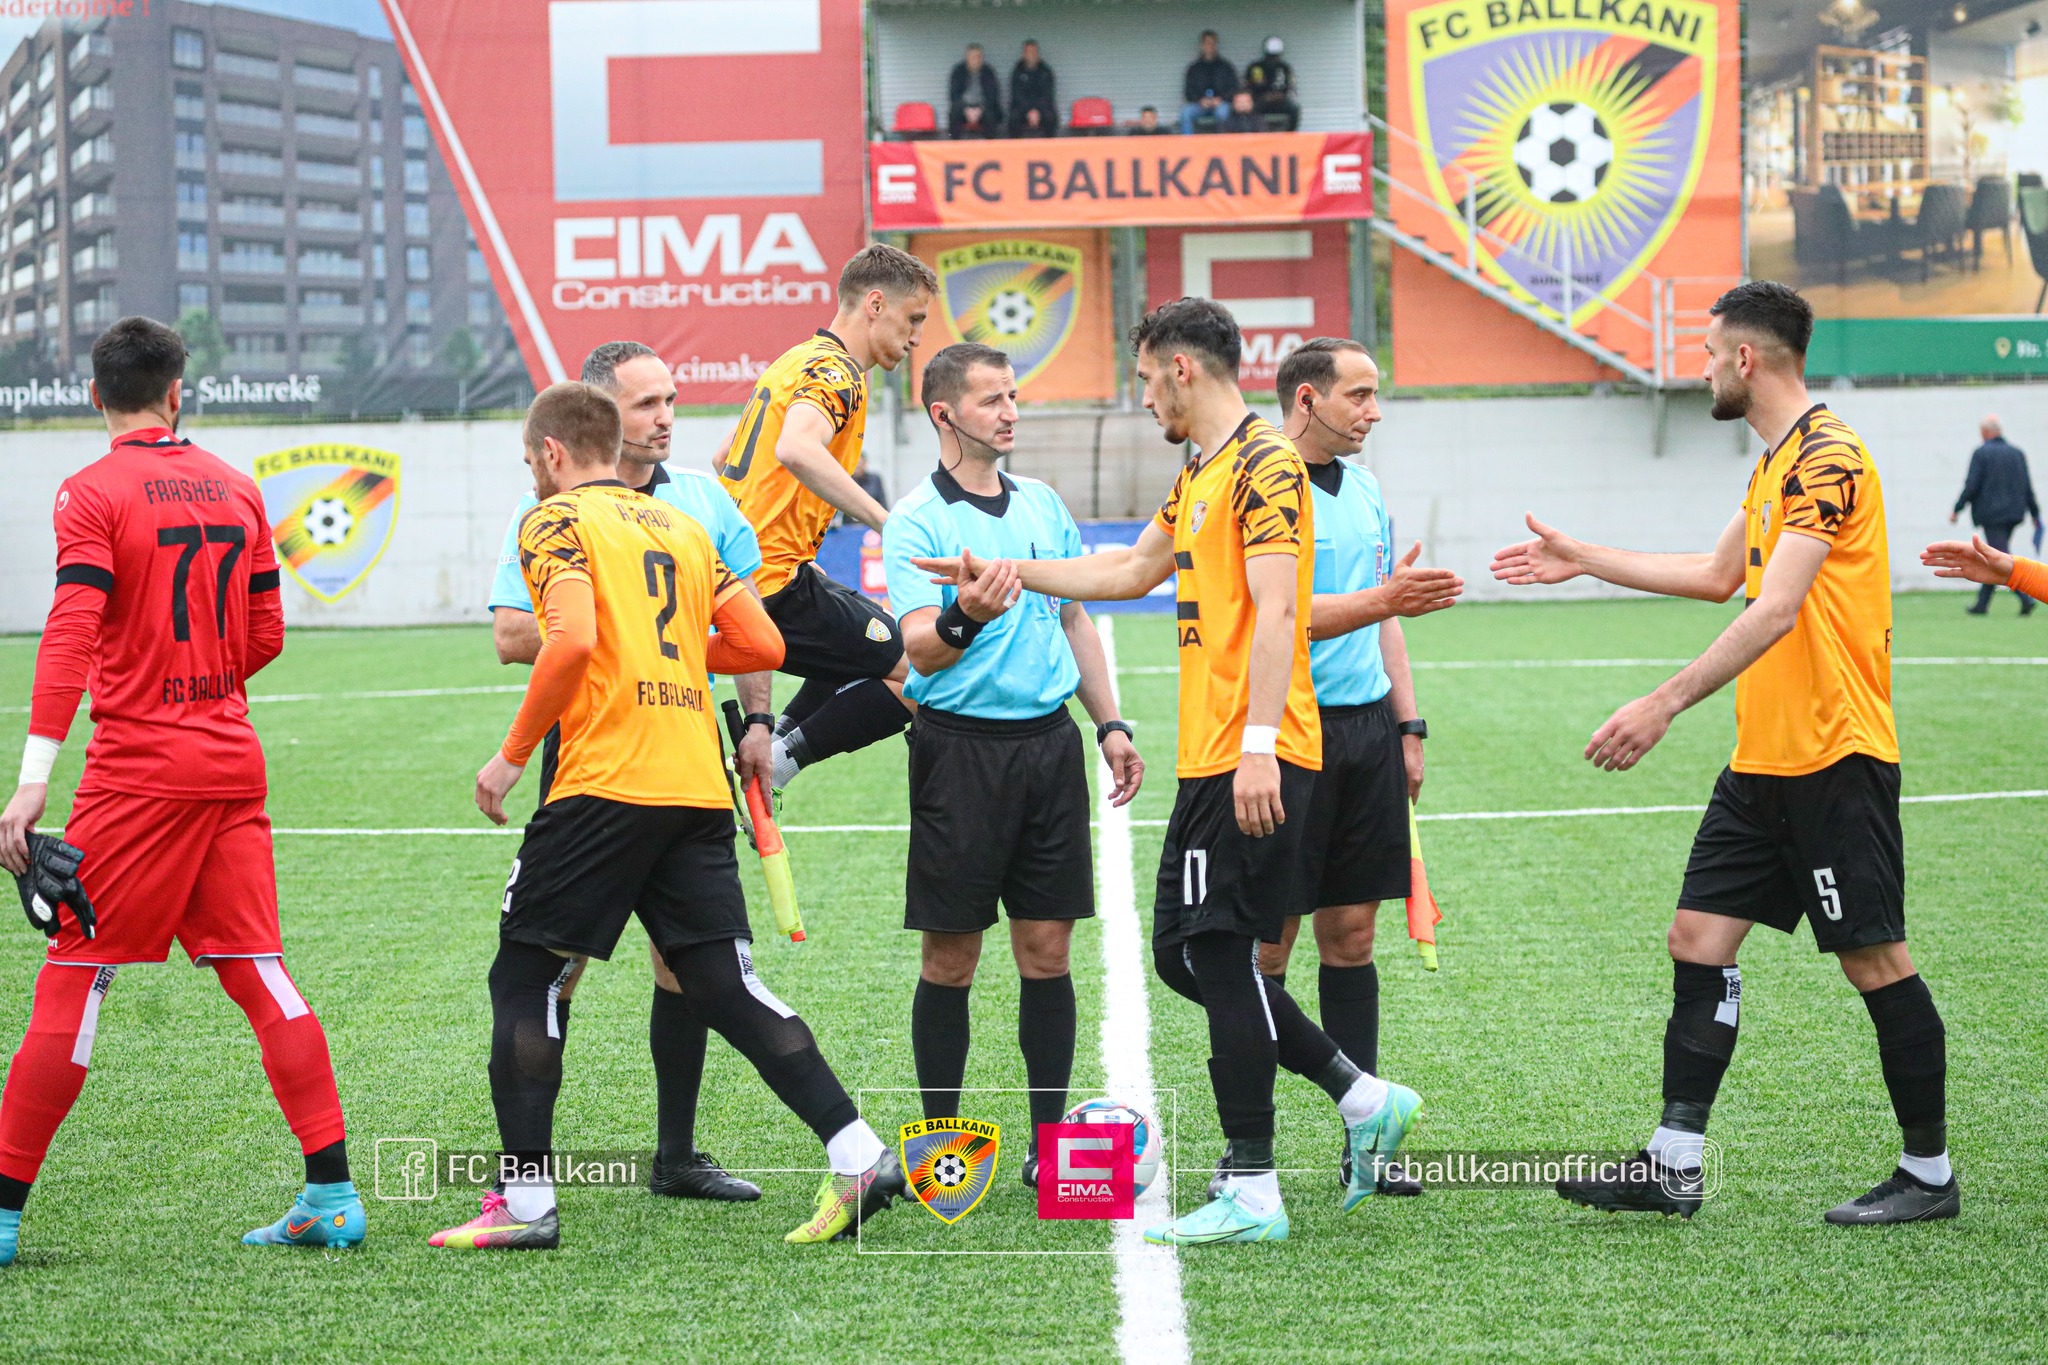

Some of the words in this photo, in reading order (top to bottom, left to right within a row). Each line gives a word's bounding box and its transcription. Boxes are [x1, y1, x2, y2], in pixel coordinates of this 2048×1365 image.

[1419, 12, 1469, 48] FC
[1485, 0, 1702, 42] BALLKANI
[944, 160, 1001, 203] FC
[1027, 155, 1298, 200] BALLKANI
[553, 213, 828, 280] CIMA
[552, 275, 832, 310] Construction
[157, 524, 246, 643] 77
[643, 549, 680, 662] 2
[163, 677, 184, 704] FC
[637, 681, 656, 706] FC
[1813, 867, 1843, 921] 5
